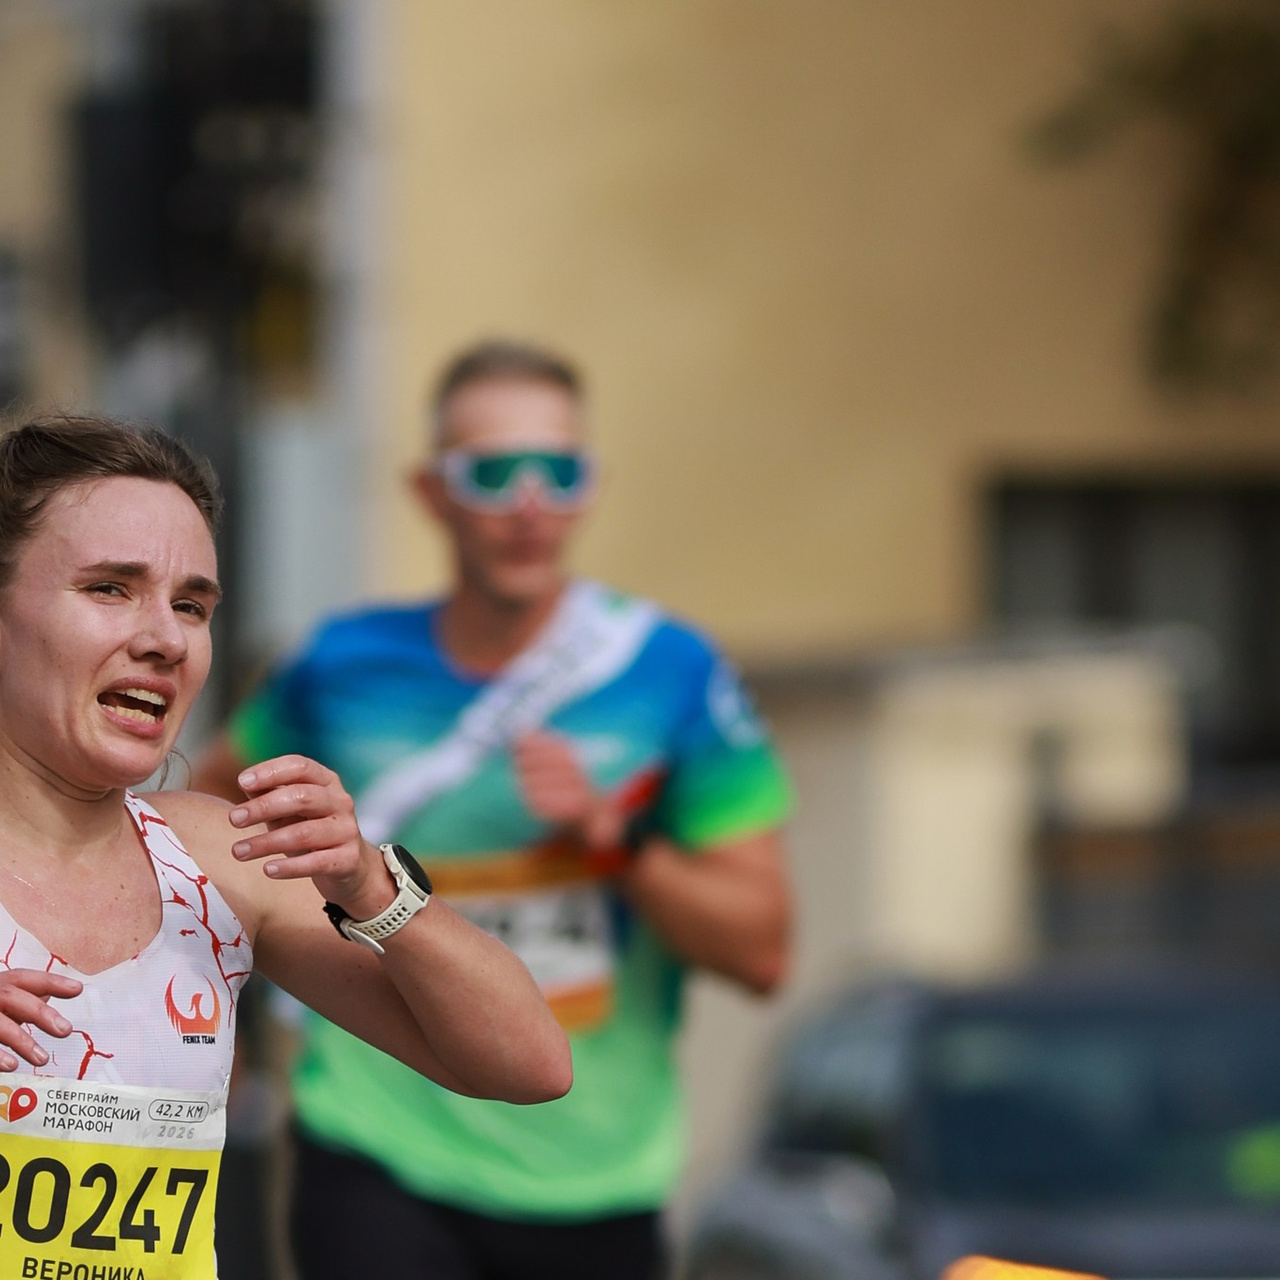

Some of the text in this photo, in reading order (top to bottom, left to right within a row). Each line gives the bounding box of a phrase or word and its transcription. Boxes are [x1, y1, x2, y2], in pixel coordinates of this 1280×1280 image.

[182, 1035, 216, 1045] FENIX TEAM
[47, 1089, 119, 1105] СБЕРПРАЙМ
[45, 1102, 141, 1122] МОСКОВСКИЙ
[155, 1103, 184, 1119] 42,2
[43, 1116, 114, 1134] МАРАФОН
